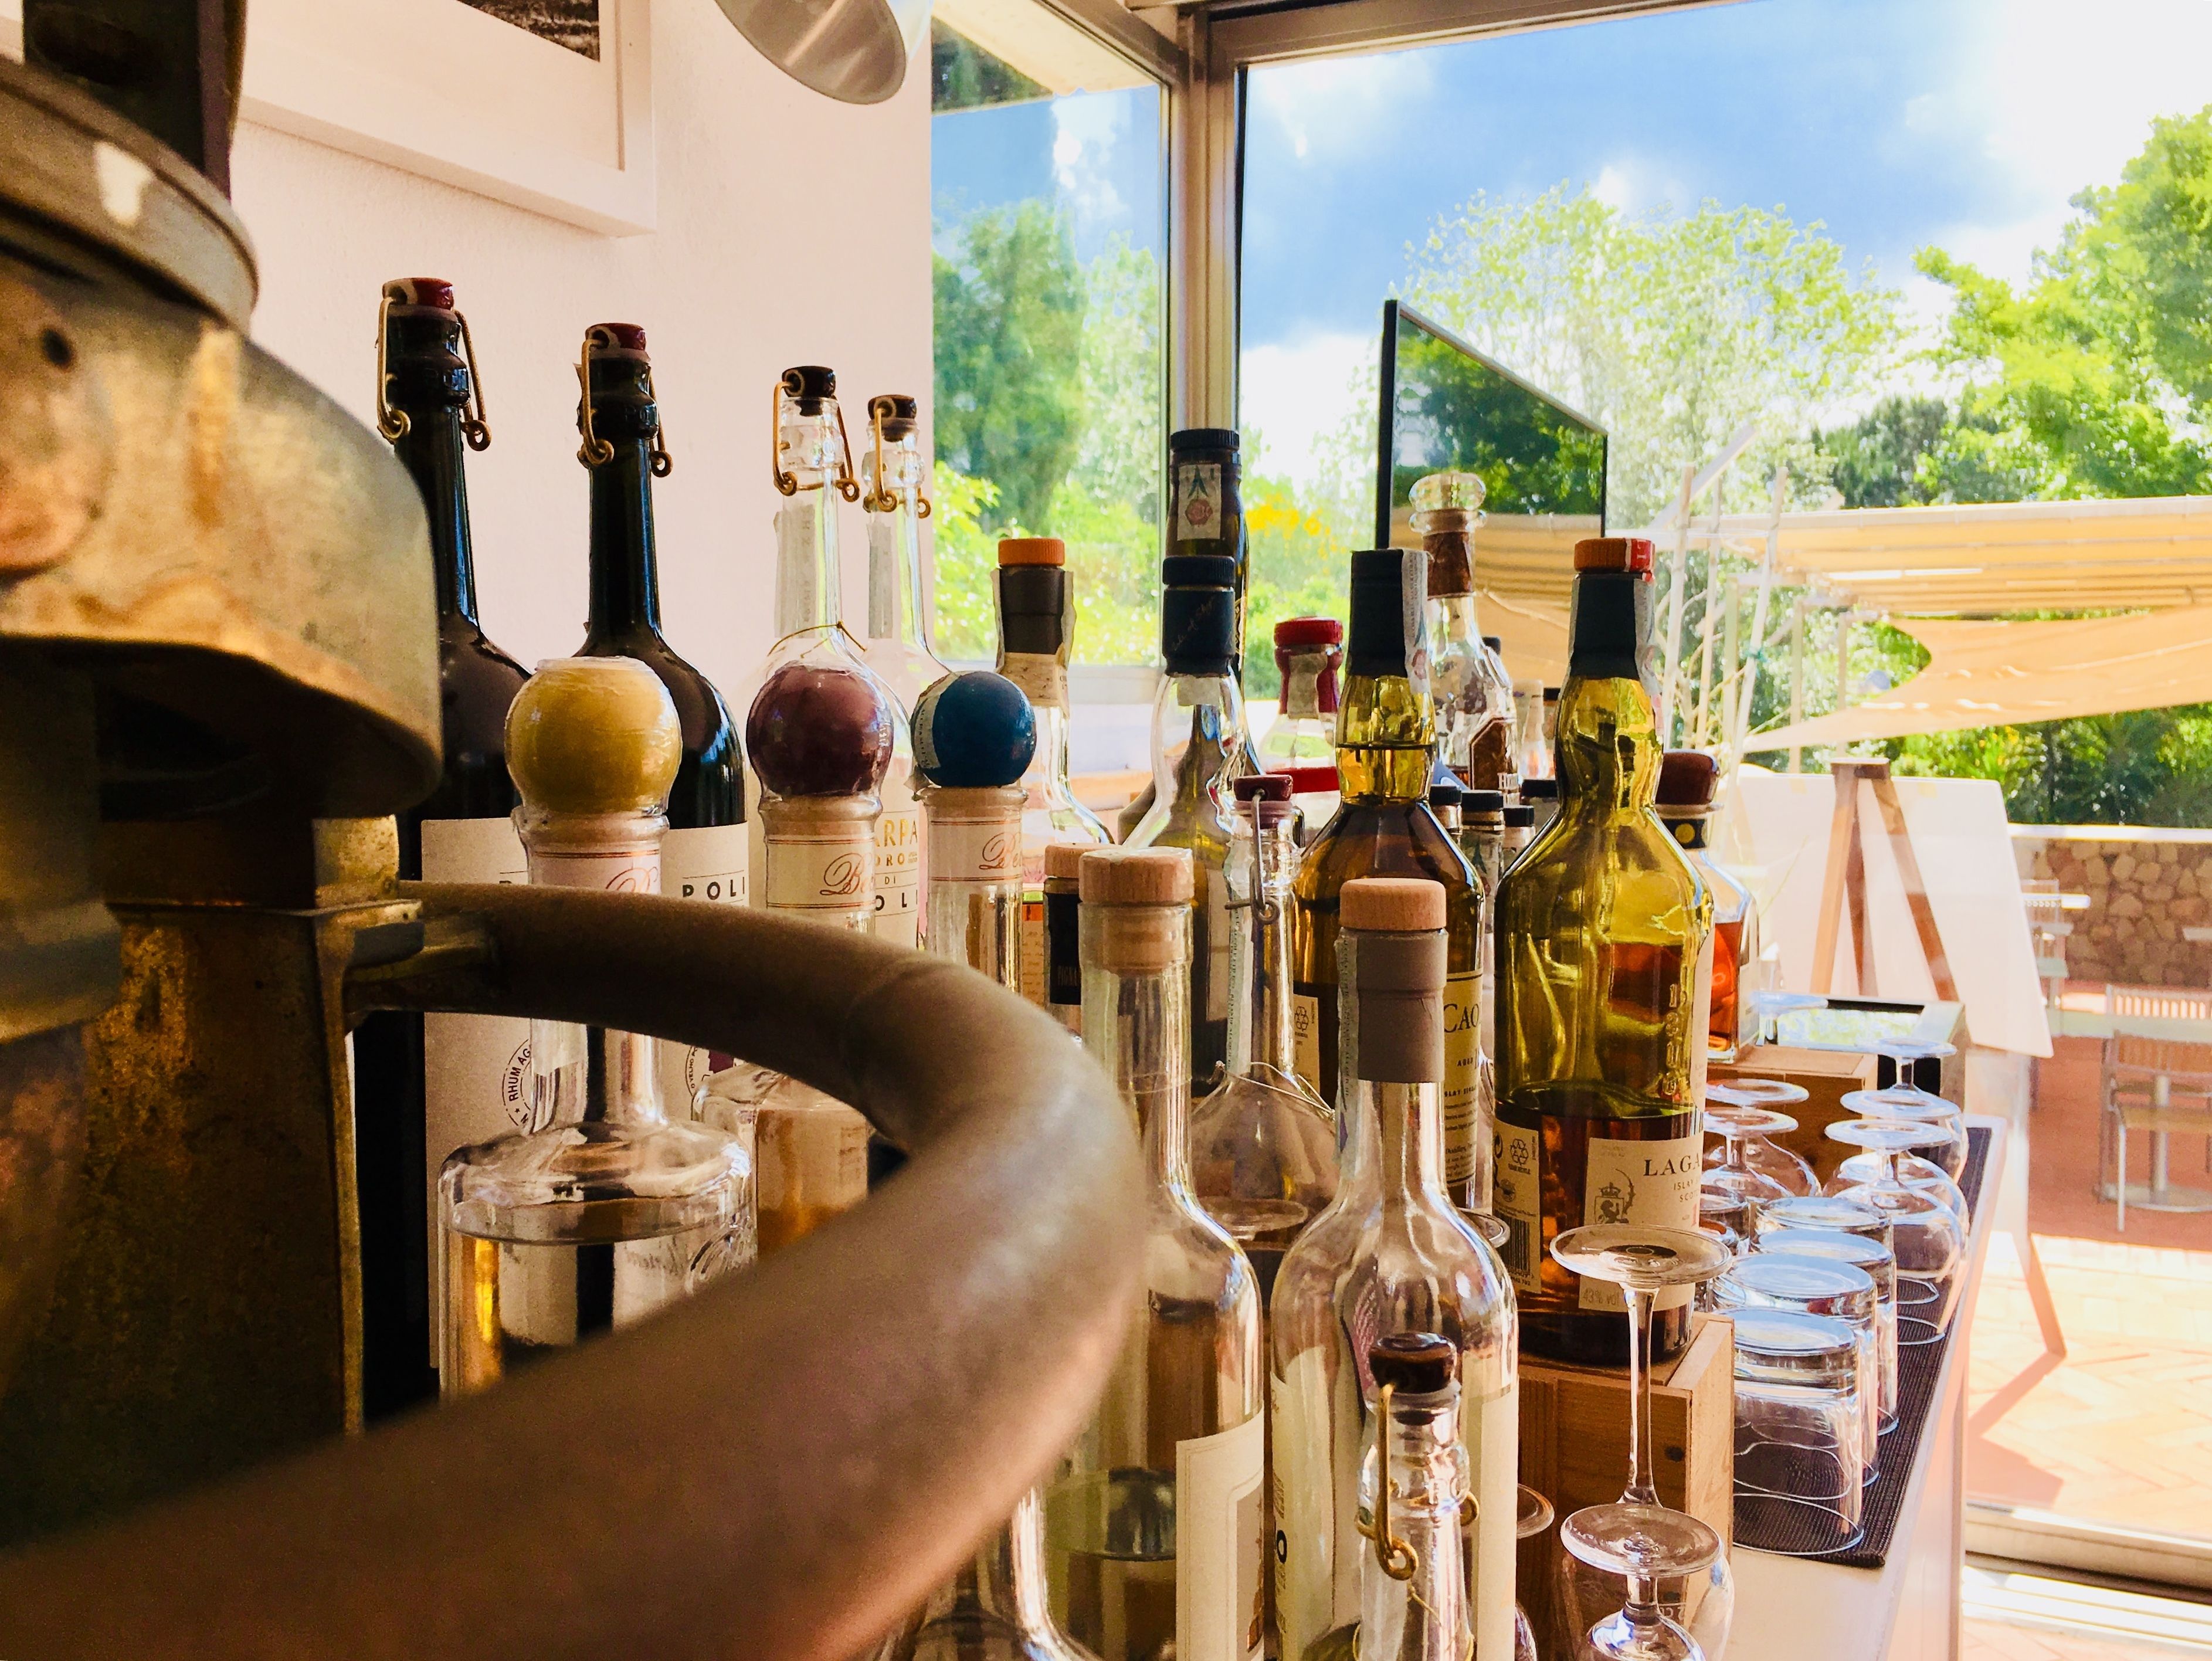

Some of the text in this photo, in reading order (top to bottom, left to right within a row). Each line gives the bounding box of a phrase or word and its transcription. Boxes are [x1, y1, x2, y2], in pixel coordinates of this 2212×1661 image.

[682, 876, 745, 900] POLI
[884, 874, 896, 886] DI
[508, 1066, 521, 1102] RHUM
[1643, 1152, 1701, 1177] LAGA
[1583, 1287, 1603, 1304] 43%
